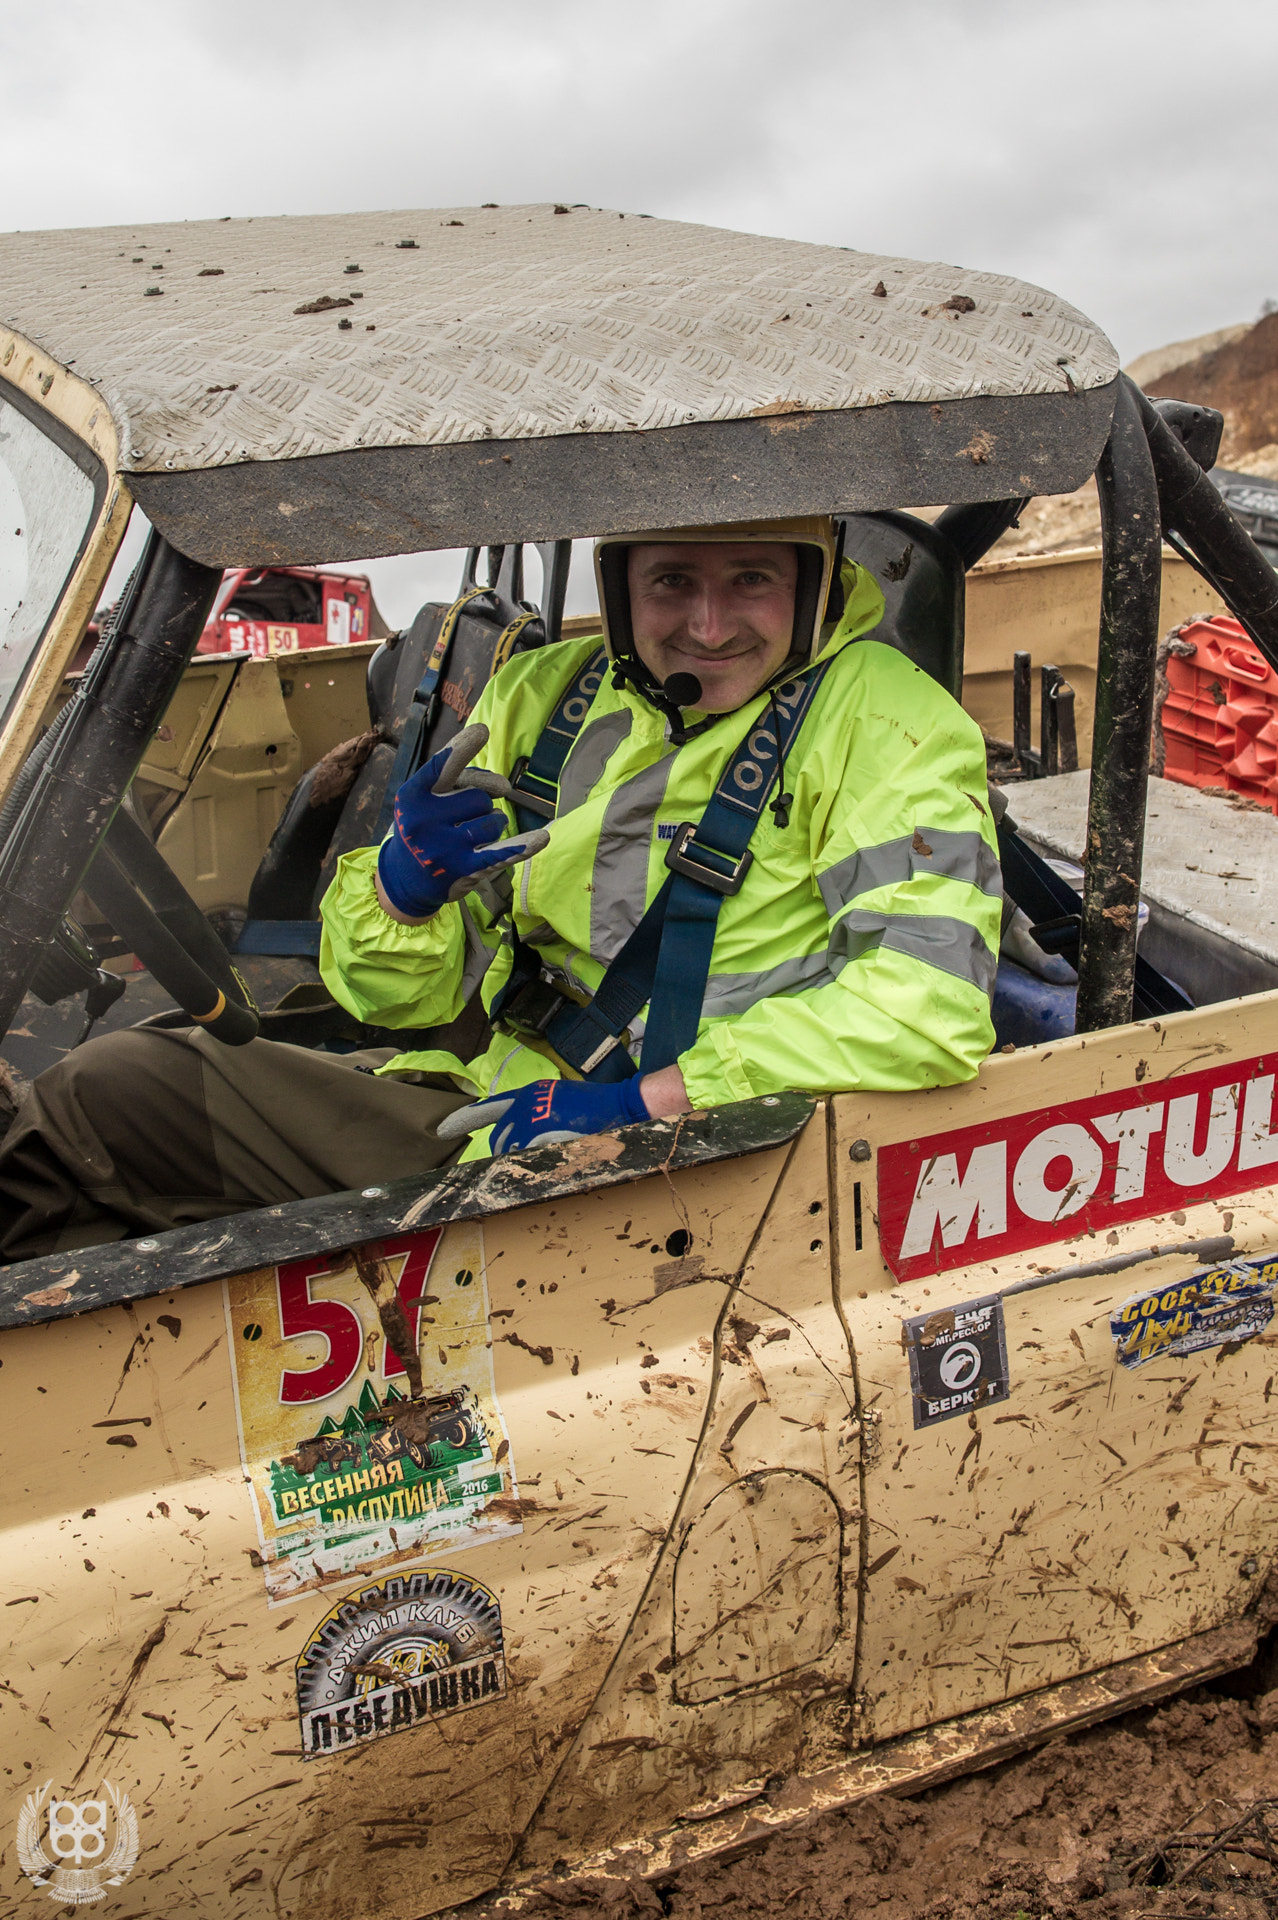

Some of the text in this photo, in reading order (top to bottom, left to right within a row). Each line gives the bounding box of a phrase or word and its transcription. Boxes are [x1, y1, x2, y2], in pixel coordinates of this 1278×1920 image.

[274, 630, 292, 649] 50
[658, 824, 679, 840] WAT
[899, 1073, 1278, 1260] MOTUL
[275, 1226, 444, 1406] 57
[280, 1460, 405, 1515] ВЕСЕННЯЯ
[331, 1477, 489, 1527] РАСПУТИЦА 2016
[328, 1603, 476, 1686] ДЖИП КЛУБ
